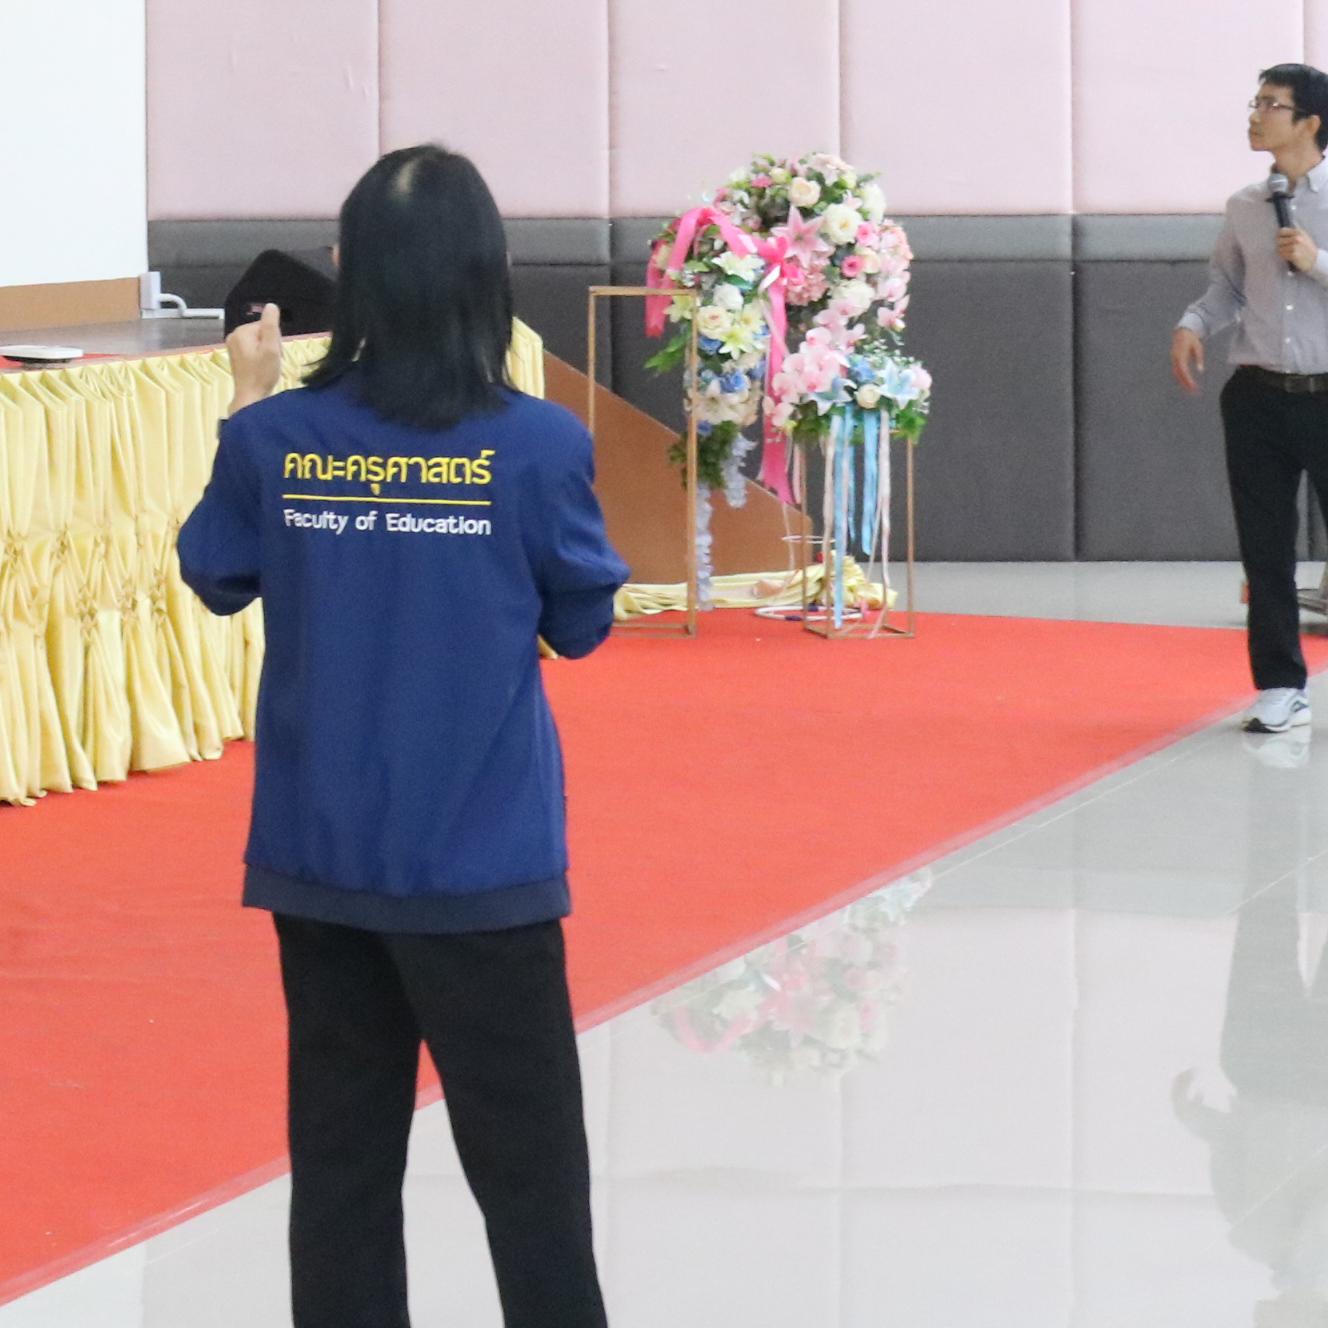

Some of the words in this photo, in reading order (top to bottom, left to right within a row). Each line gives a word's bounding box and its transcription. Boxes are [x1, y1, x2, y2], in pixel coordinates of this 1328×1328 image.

[283, 450, 496, 495] คณะครุศาสตร์
[283, 508, 350, 535] Faculty
[354, 510, 379, 532] of
[385, 512, 492, 536] Education
